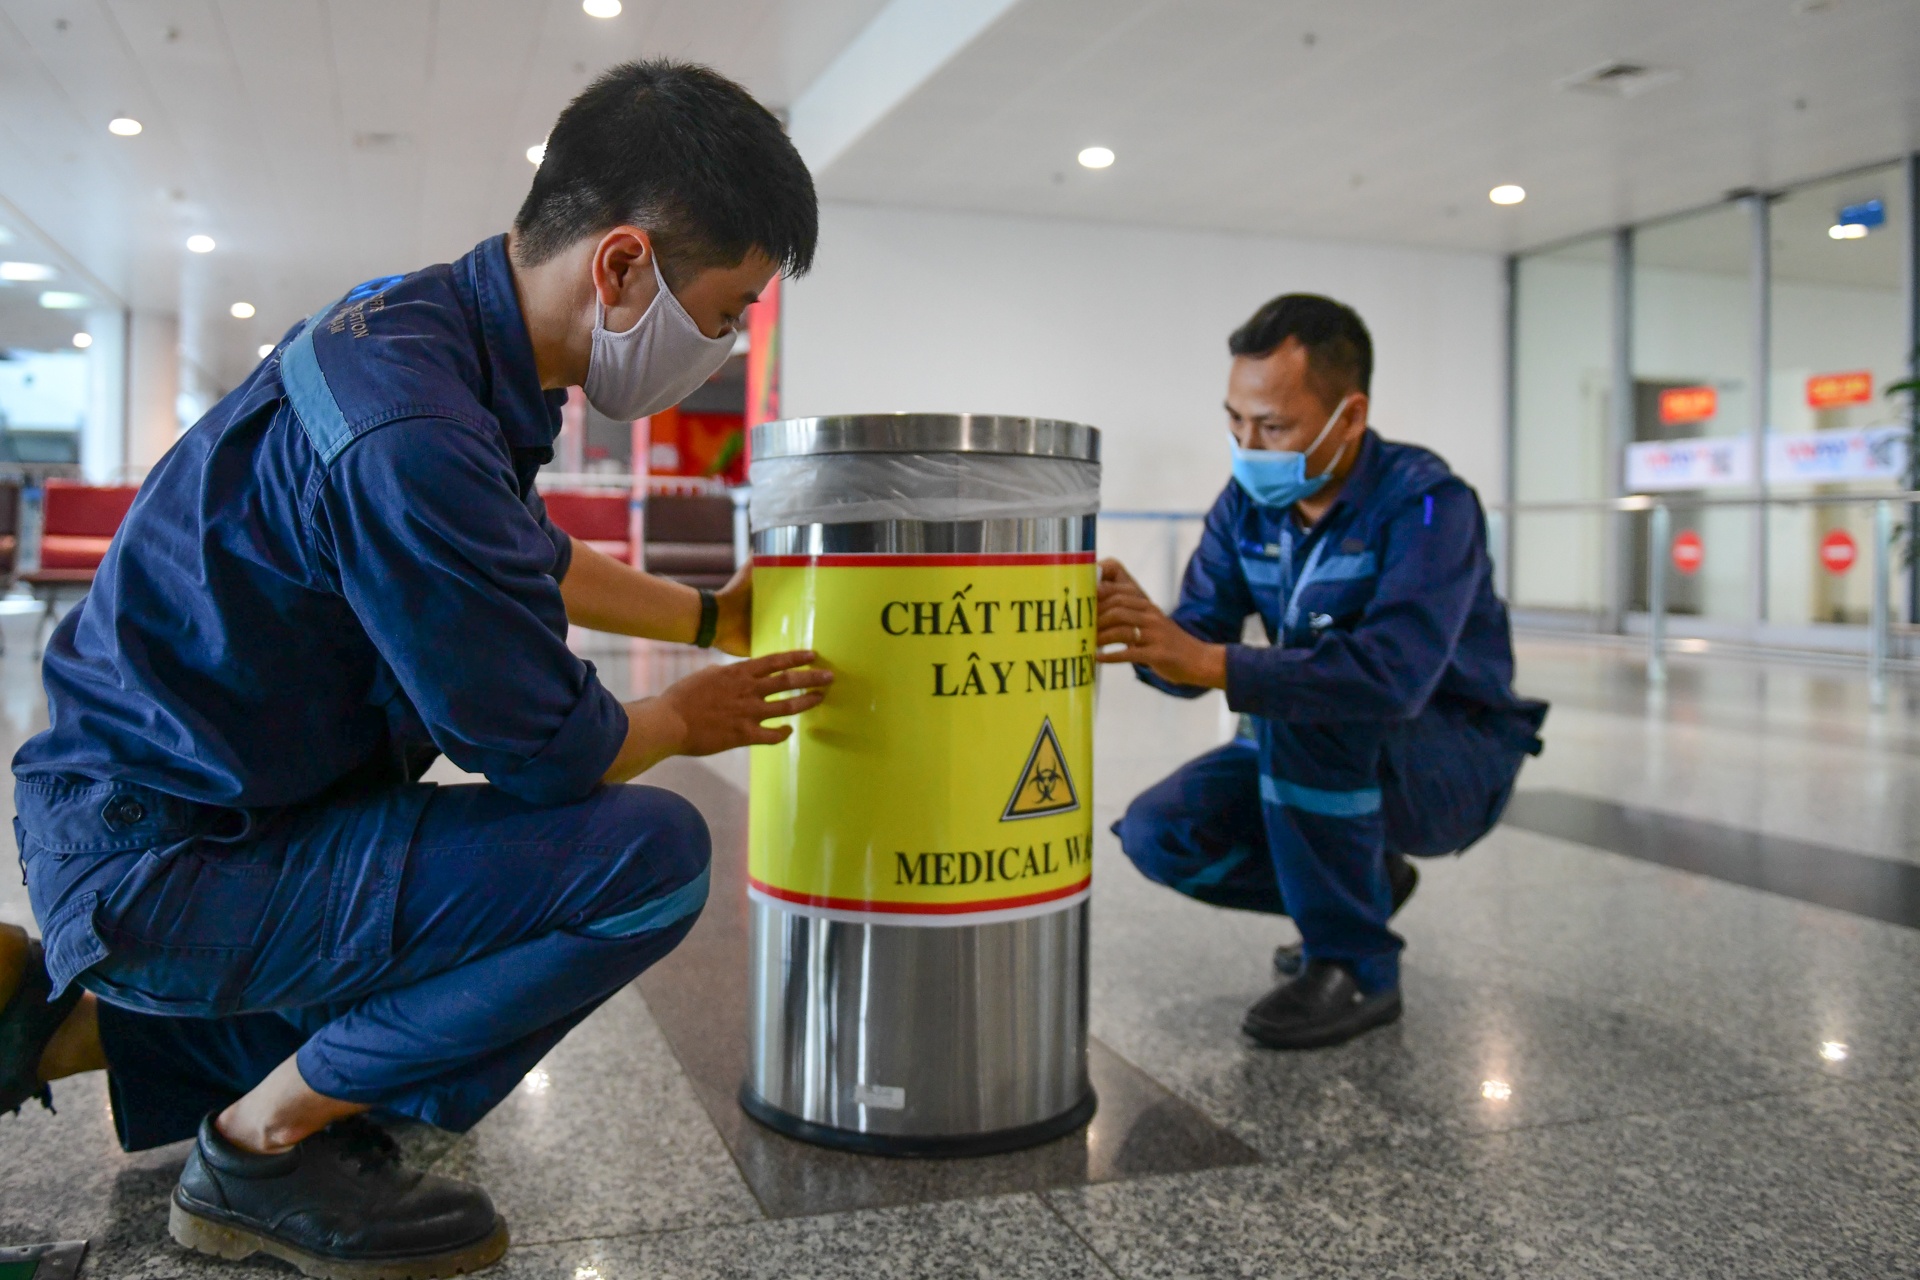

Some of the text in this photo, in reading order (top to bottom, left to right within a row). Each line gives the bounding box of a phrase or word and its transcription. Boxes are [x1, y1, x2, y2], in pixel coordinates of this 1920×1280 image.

[881, 583, 1000, 636] CHẤT
[1010, 586, 1083, 633] THẢI
[932, 651, 1015, 697] LÂY
[895, 831, 1092, 886] MEDICAL WA
